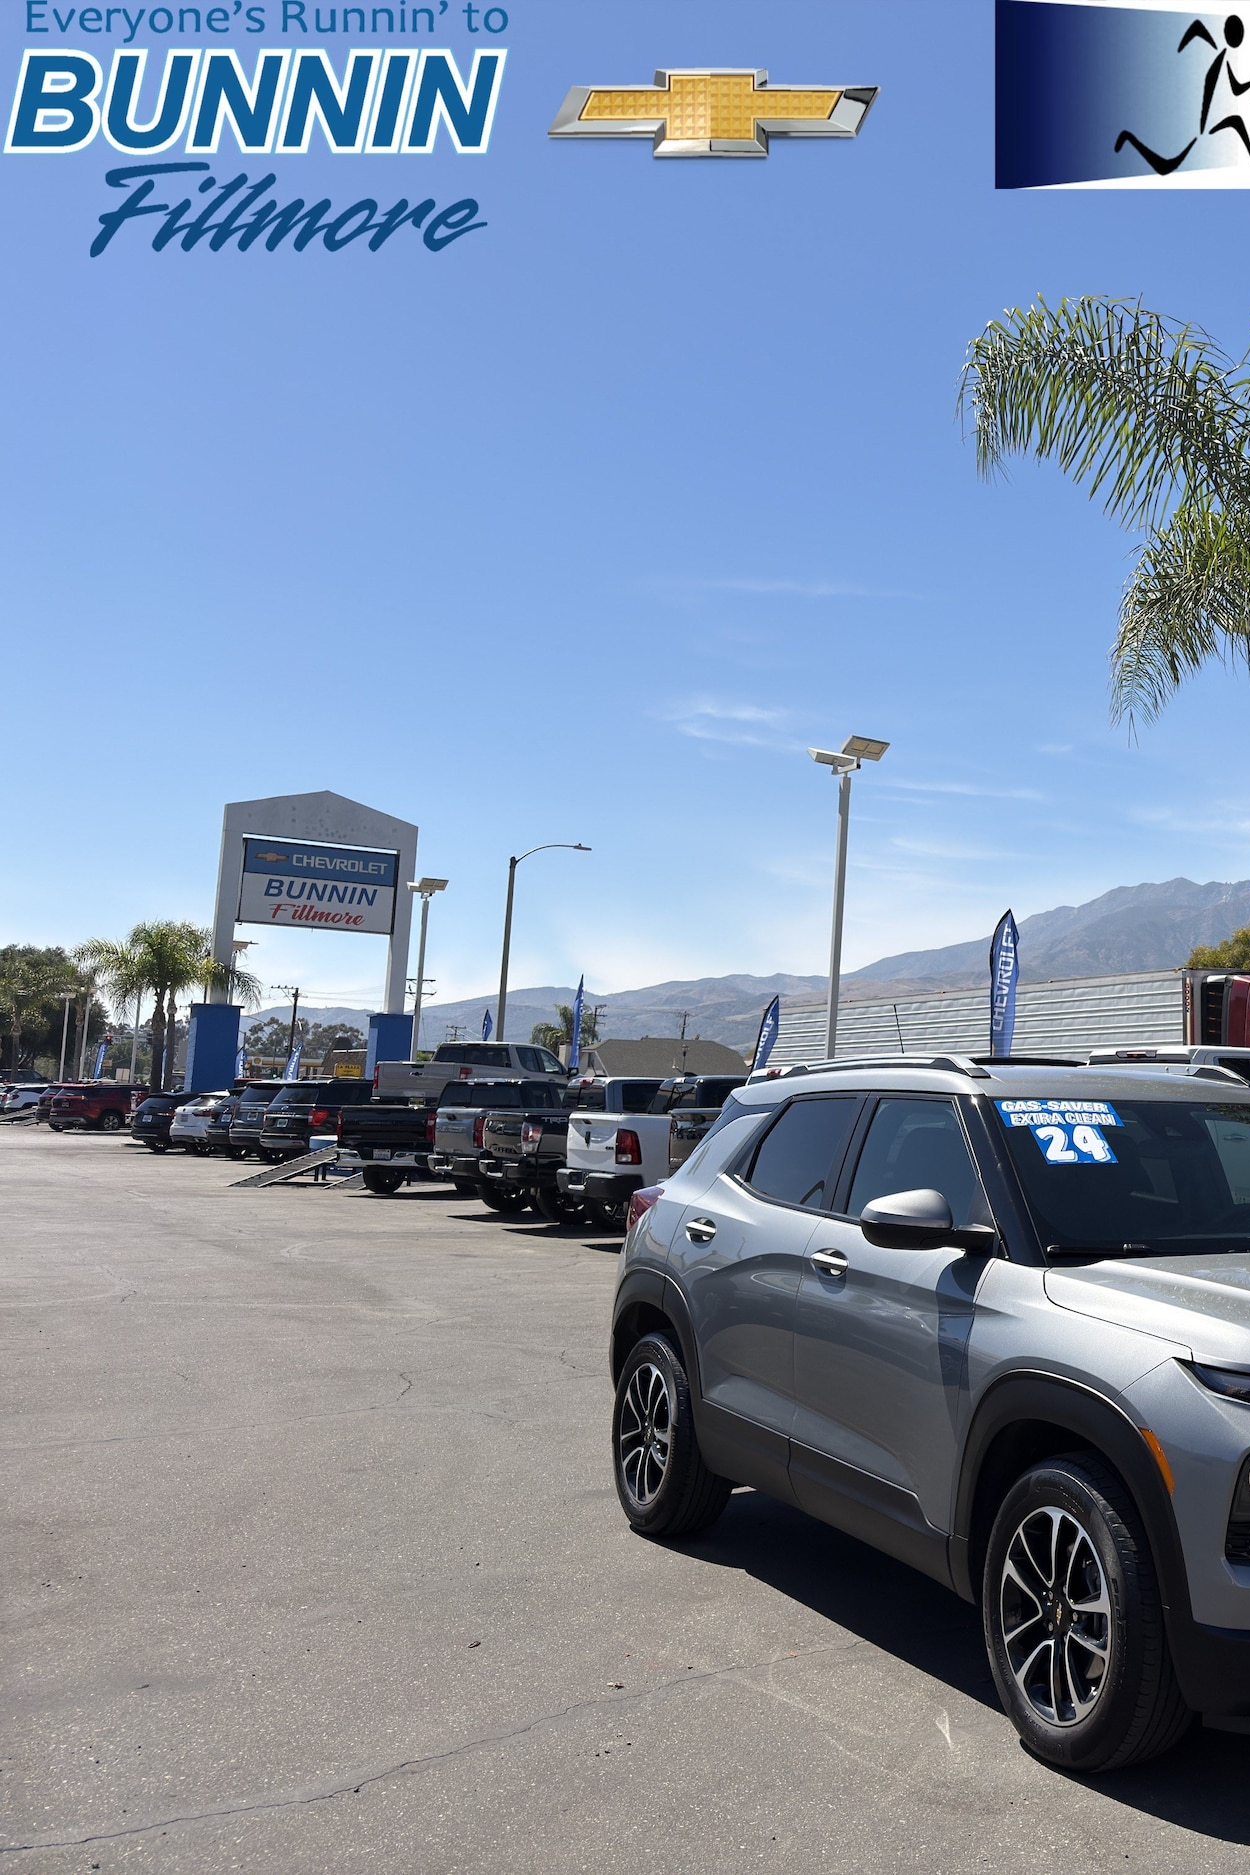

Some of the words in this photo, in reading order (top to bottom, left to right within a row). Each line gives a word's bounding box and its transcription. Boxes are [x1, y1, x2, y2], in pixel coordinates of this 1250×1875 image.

[292, 854, 388, 875] CHEVROLET
[264, 878, 378, 907] BUNNIN
[269, 903, 365, 926] Fillmore
[1001, 1100, 1109, 1113] GAS-SAVER
[1010, 1112, 1066, 1126] EXTRA
[1065, 1113, 1117, 1126] CLEAN
[1035, 1125, 1111, 1163] 24
